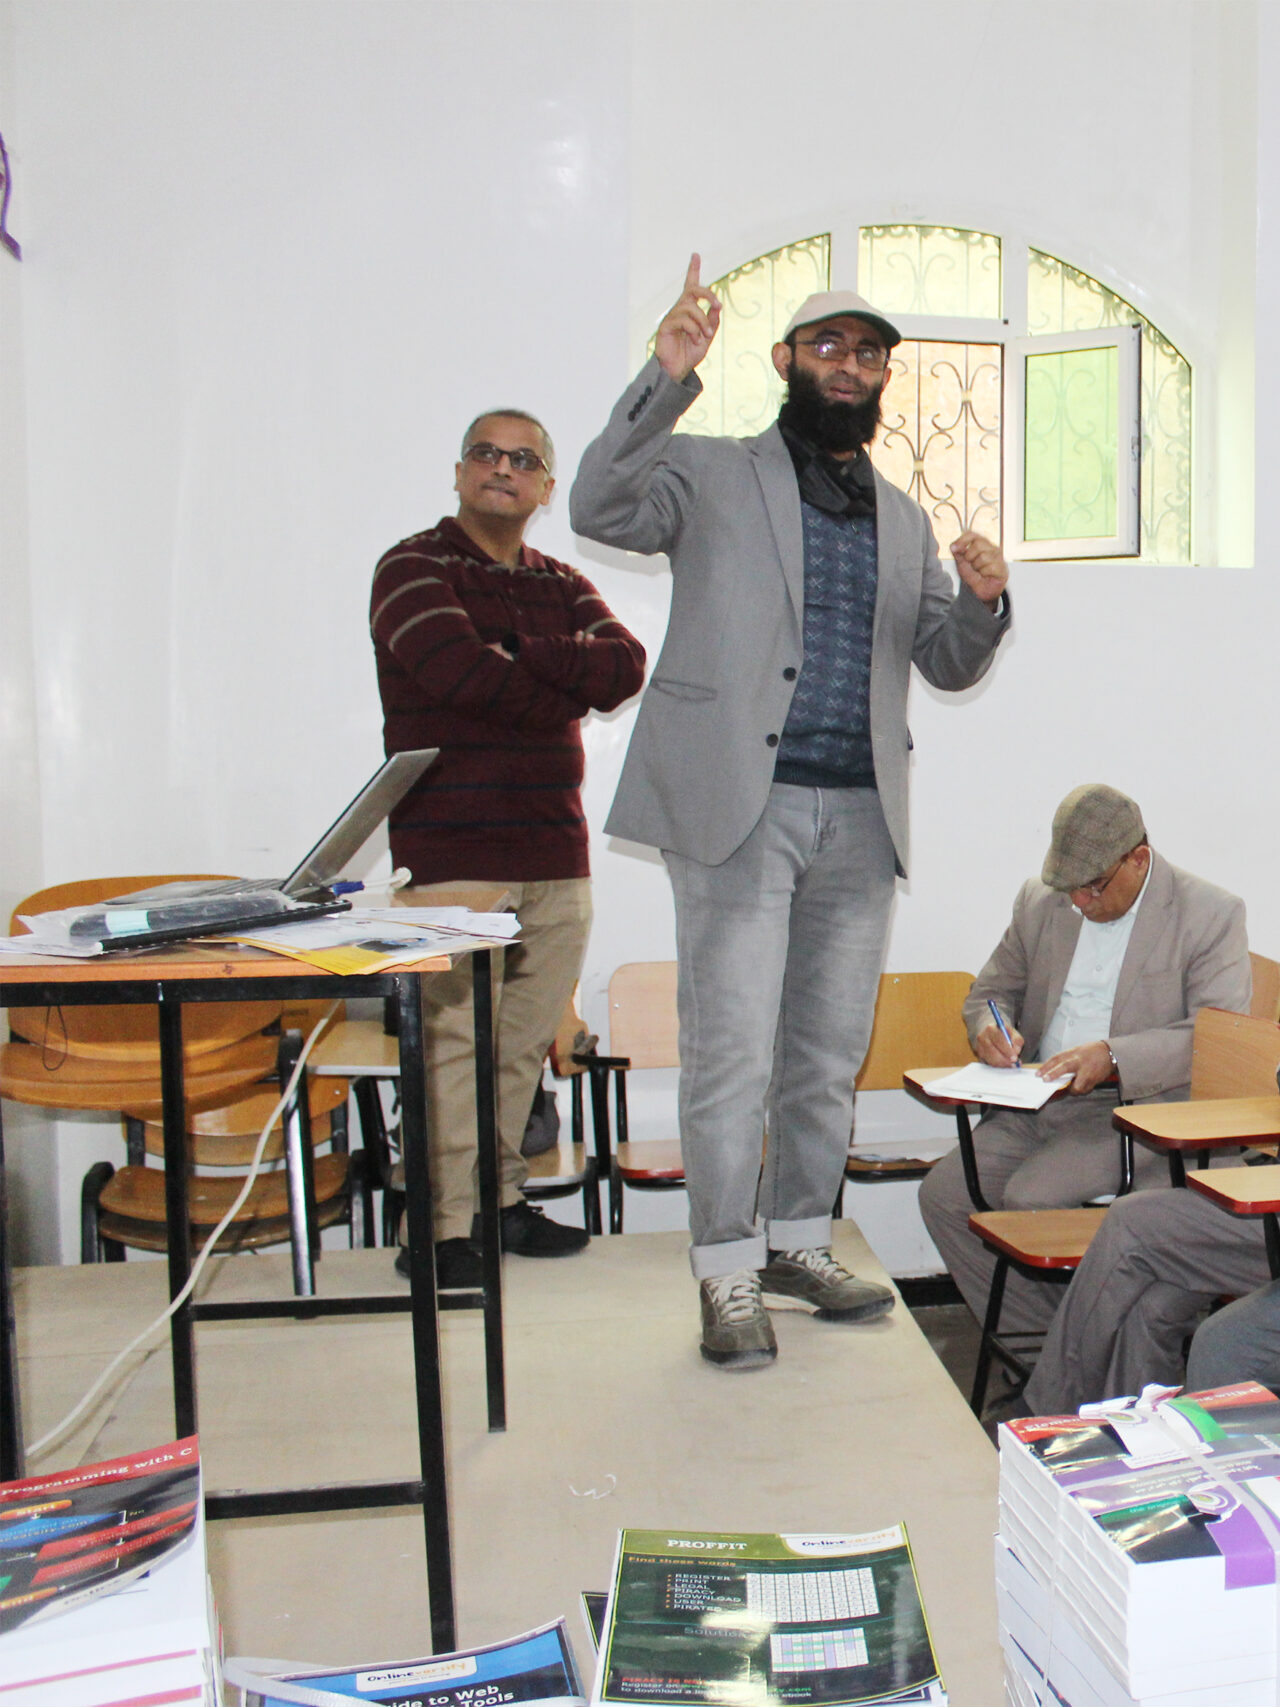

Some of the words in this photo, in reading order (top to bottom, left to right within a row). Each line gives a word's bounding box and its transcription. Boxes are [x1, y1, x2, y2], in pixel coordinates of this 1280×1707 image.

[1, 1465, 129, 1496] Programming
[134, 1453, 175, 1470] with
[180, 1447, 193, 1457] C
[667, 1539, 748, 1550] PROFFIT
[675, 1573, 731, 1581] REGISTER
[674, 1593, 742, 1603] DOWNLOAD
[621, 1681, 662, 1689] Register
[428, 1696, 450, 1706] to
[455, 1685, 500, 1701] Web
[460, 1692, 515, 1707] Tools
